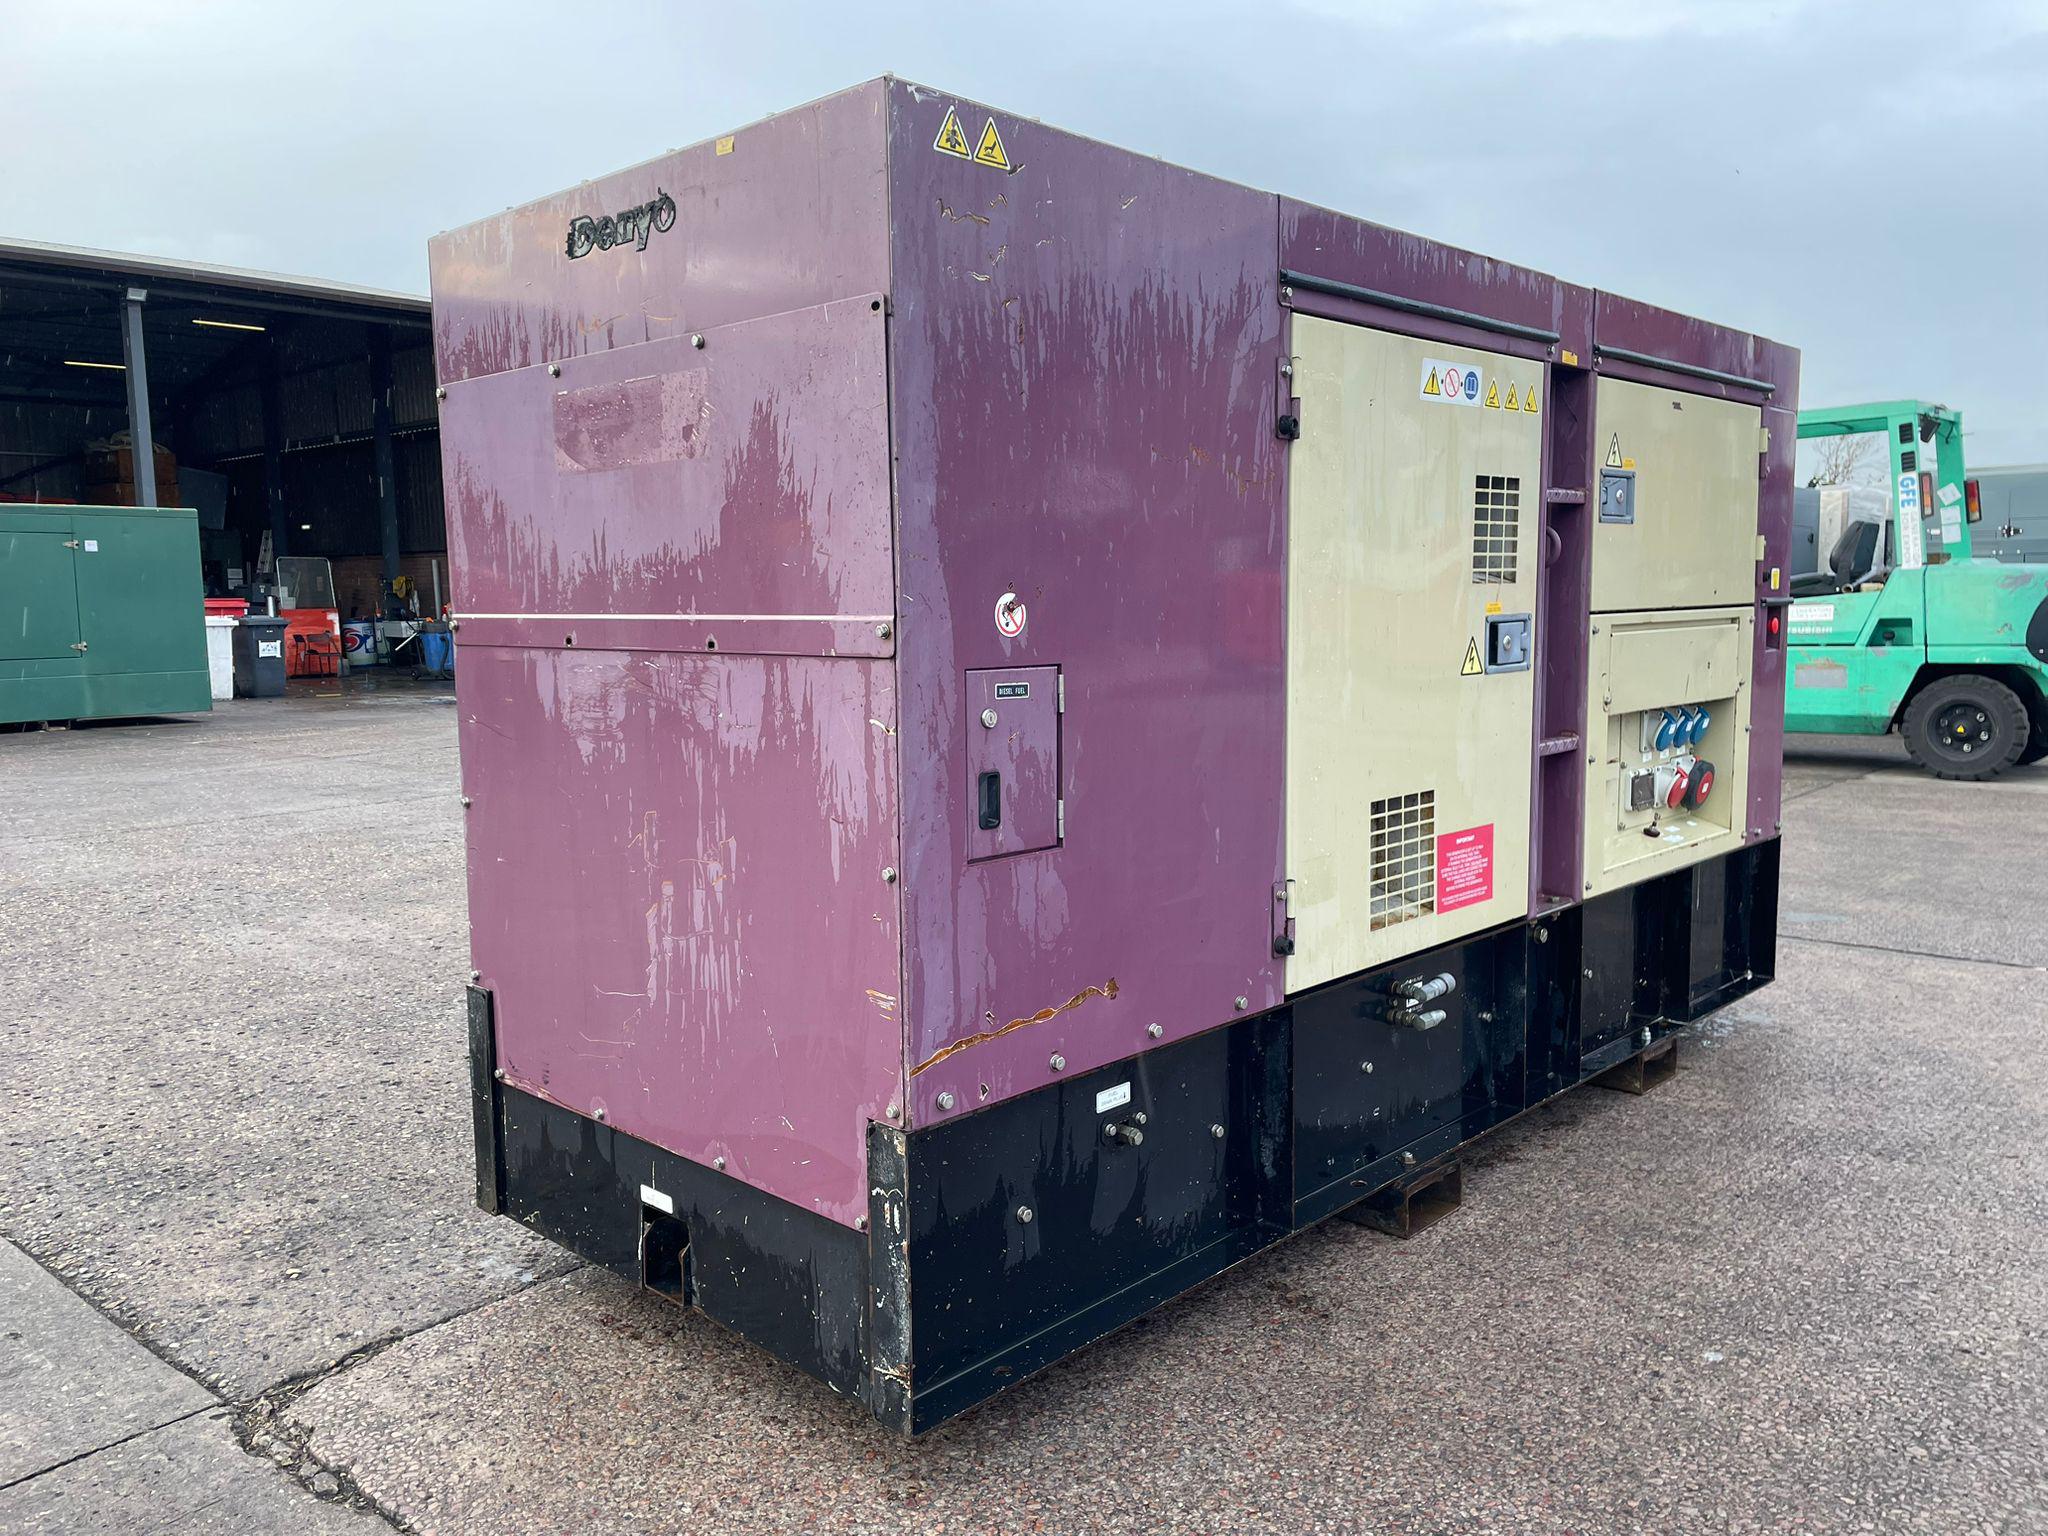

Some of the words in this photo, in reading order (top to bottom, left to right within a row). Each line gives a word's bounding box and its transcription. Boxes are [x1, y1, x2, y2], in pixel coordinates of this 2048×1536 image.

[566, 189, 676, 260] Denyo
[1900, 476, 1917, 508] GFE
[1015, 687, 1025, 695] FUEL
